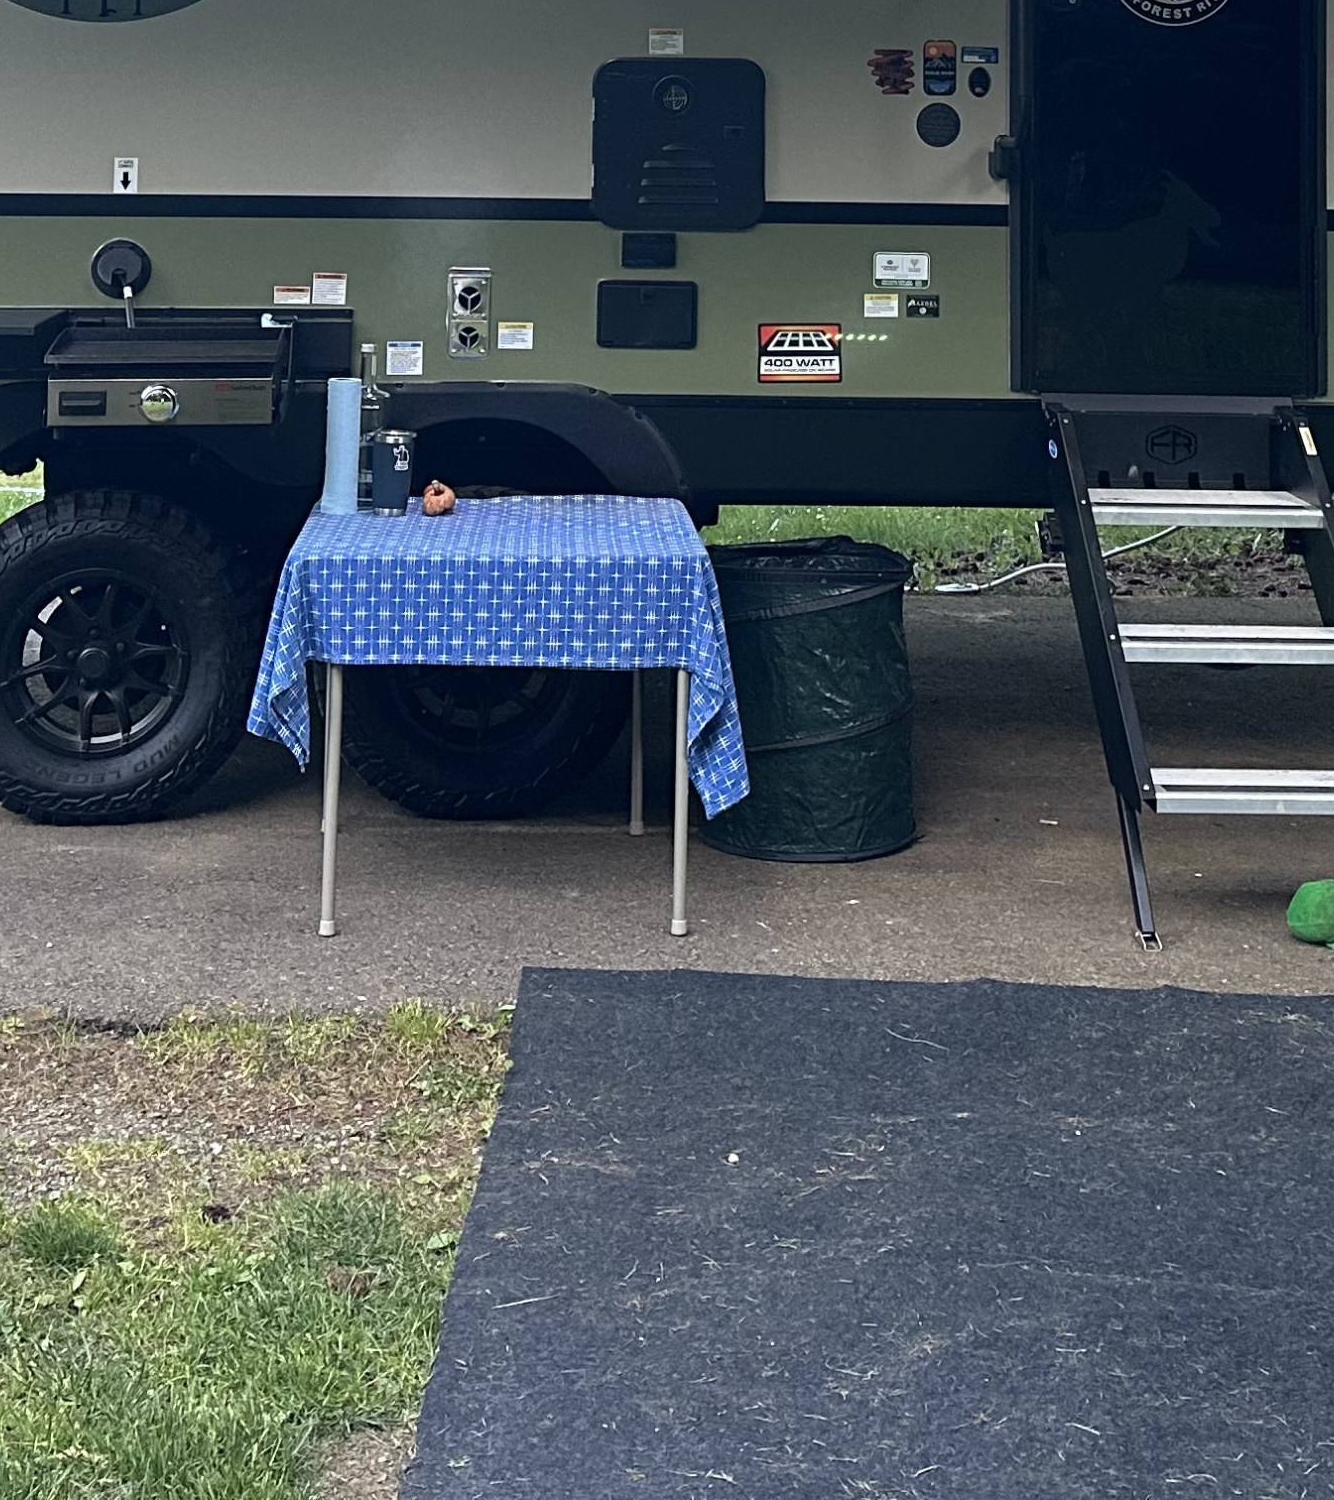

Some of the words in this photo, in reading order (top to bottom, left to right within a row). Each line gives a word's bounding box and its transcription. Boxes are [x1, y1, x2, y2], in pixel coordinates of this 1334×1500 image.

[764, 359, 793, 367] 400
[796, 359, 836, 367] WATT
[135, 734, 179, 773] MUD
